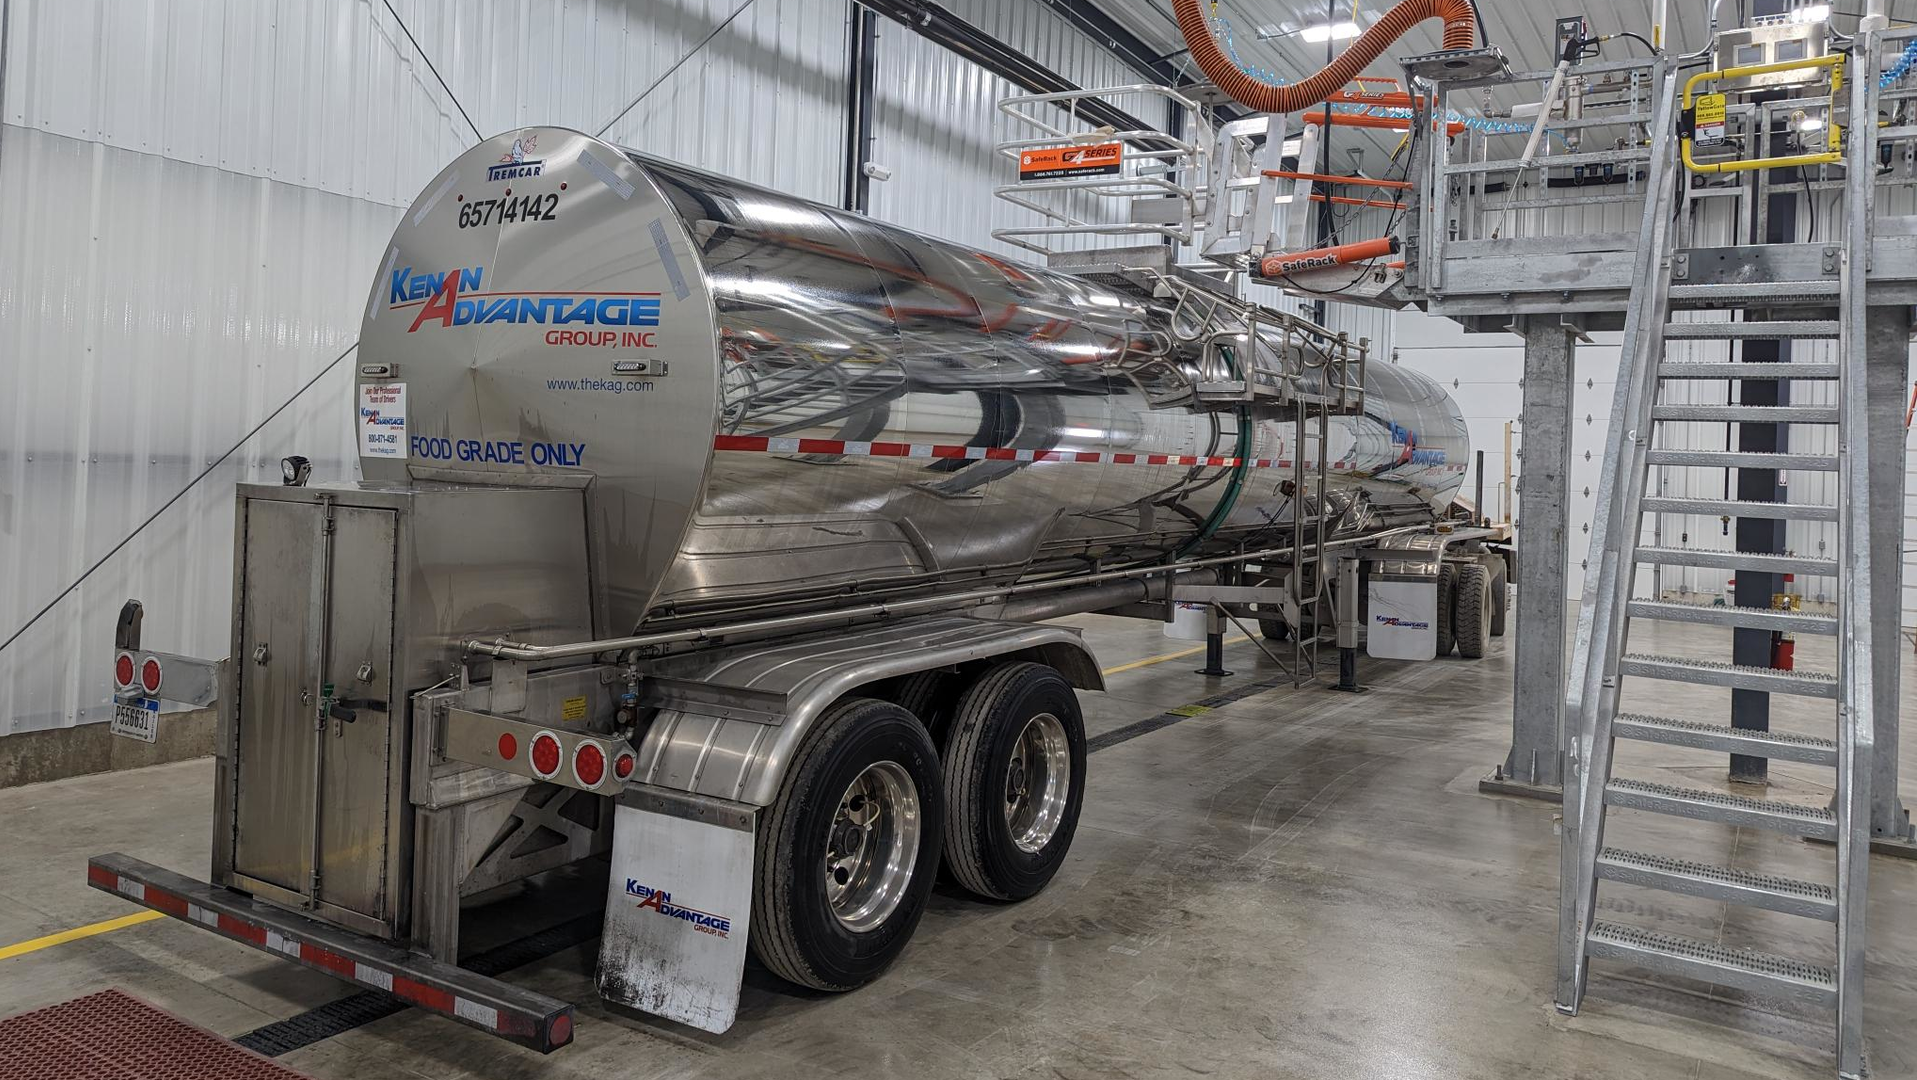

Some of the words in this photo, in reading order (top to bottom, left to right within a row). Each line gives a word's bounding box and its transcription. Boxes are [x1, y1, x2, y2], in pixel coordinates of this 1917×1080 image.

[1031, 155, 1057, 163] SafeRack
[1085, 147, 1117, 158] SERIES
[488, 161, 541, 181] TREMCAR
[459, 193, 559, 229] 65714142
[1282, 255, 1336, 271] SafeRack
[390, 267, 483, 304] KENAN
[407, 277, 661, 333] ADVANTAGE
[545, 330, 617, 349] GROUP,
[622, 332, 658, 348] INC.
[547, 378, 654, 394] www.thekag.com
[366, 412, 404, 425] ADVANTAGE
[411, 436, 452, 459] FOOD
[456, 439, 525, 465] GRADE
[530, 442, 586, 466] ONLY
[115, 705, 149, 730] P556631
[626, 878, 671, 903] KENAN
[637, 892, 730, 931] ADVANTAGE
